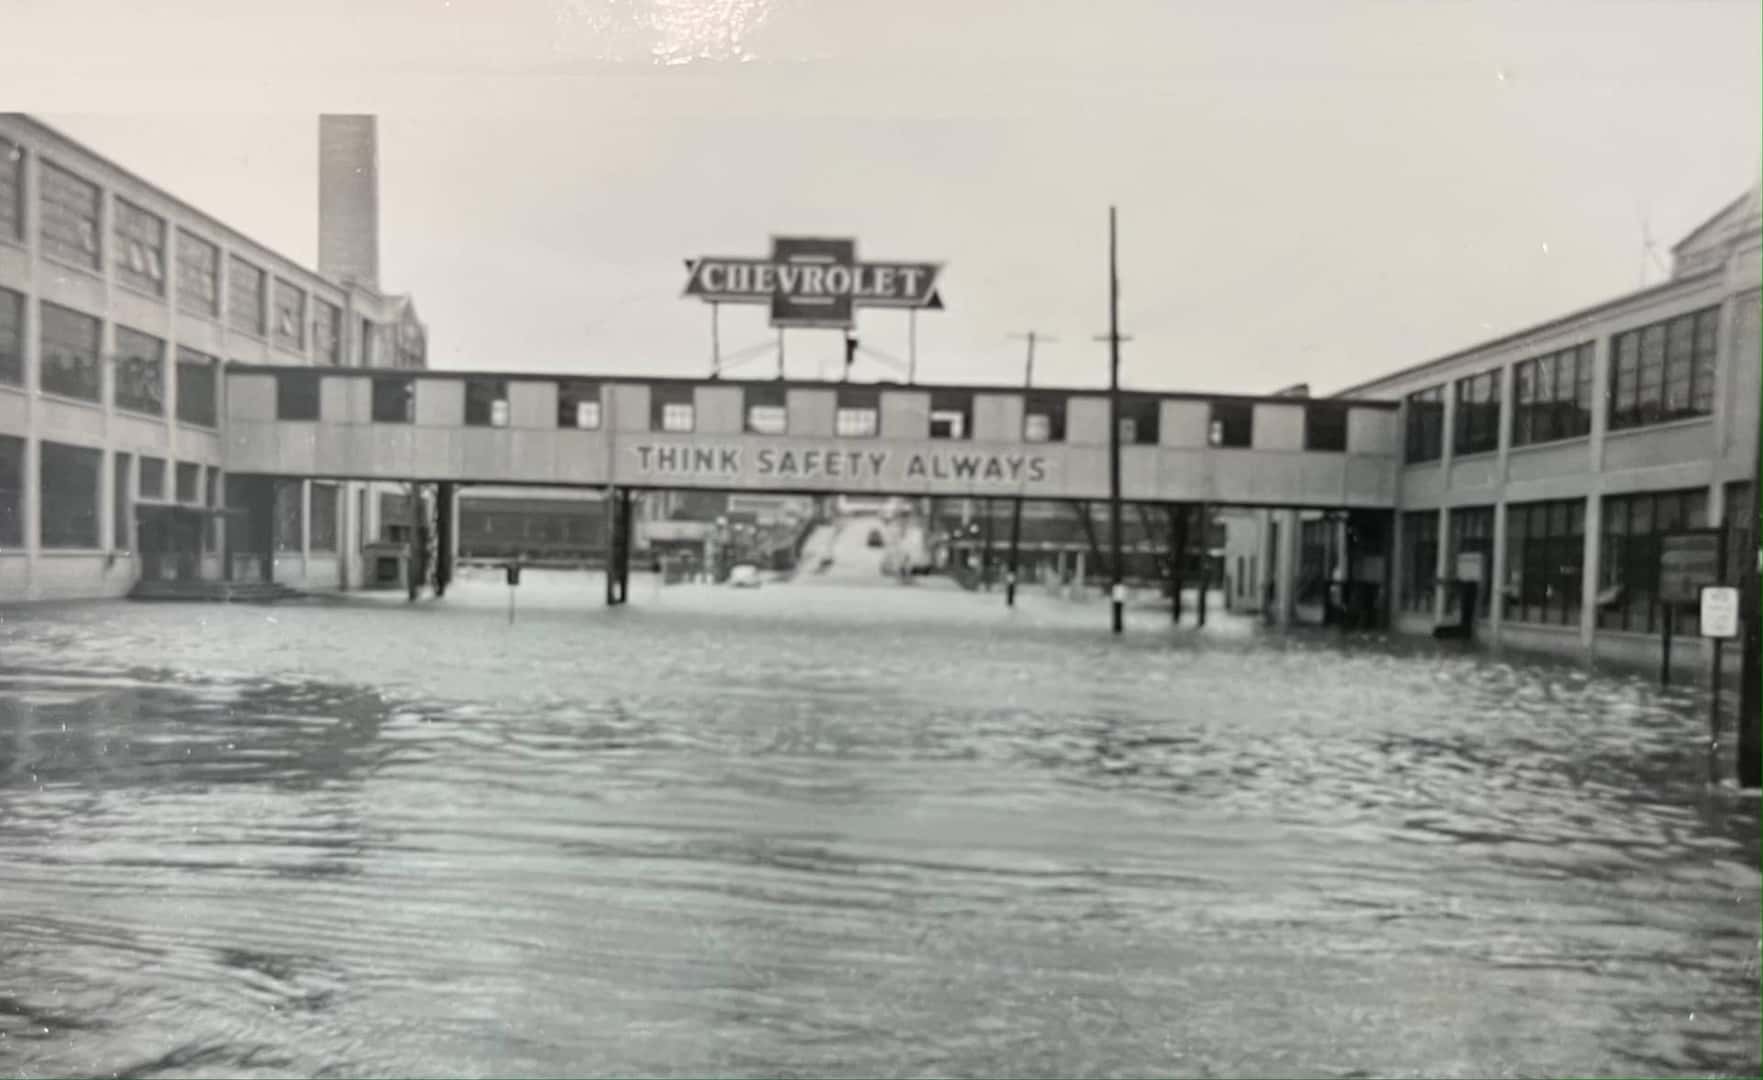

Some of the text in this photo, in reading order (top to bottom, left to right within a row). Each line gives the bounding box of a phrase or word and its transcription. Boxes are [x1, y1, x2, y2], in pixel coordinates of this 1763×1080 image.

[700, 262, 924, 297] CHEVROLET
[637, 446, 1048, 482] THINK SAFETY ALWAYS
